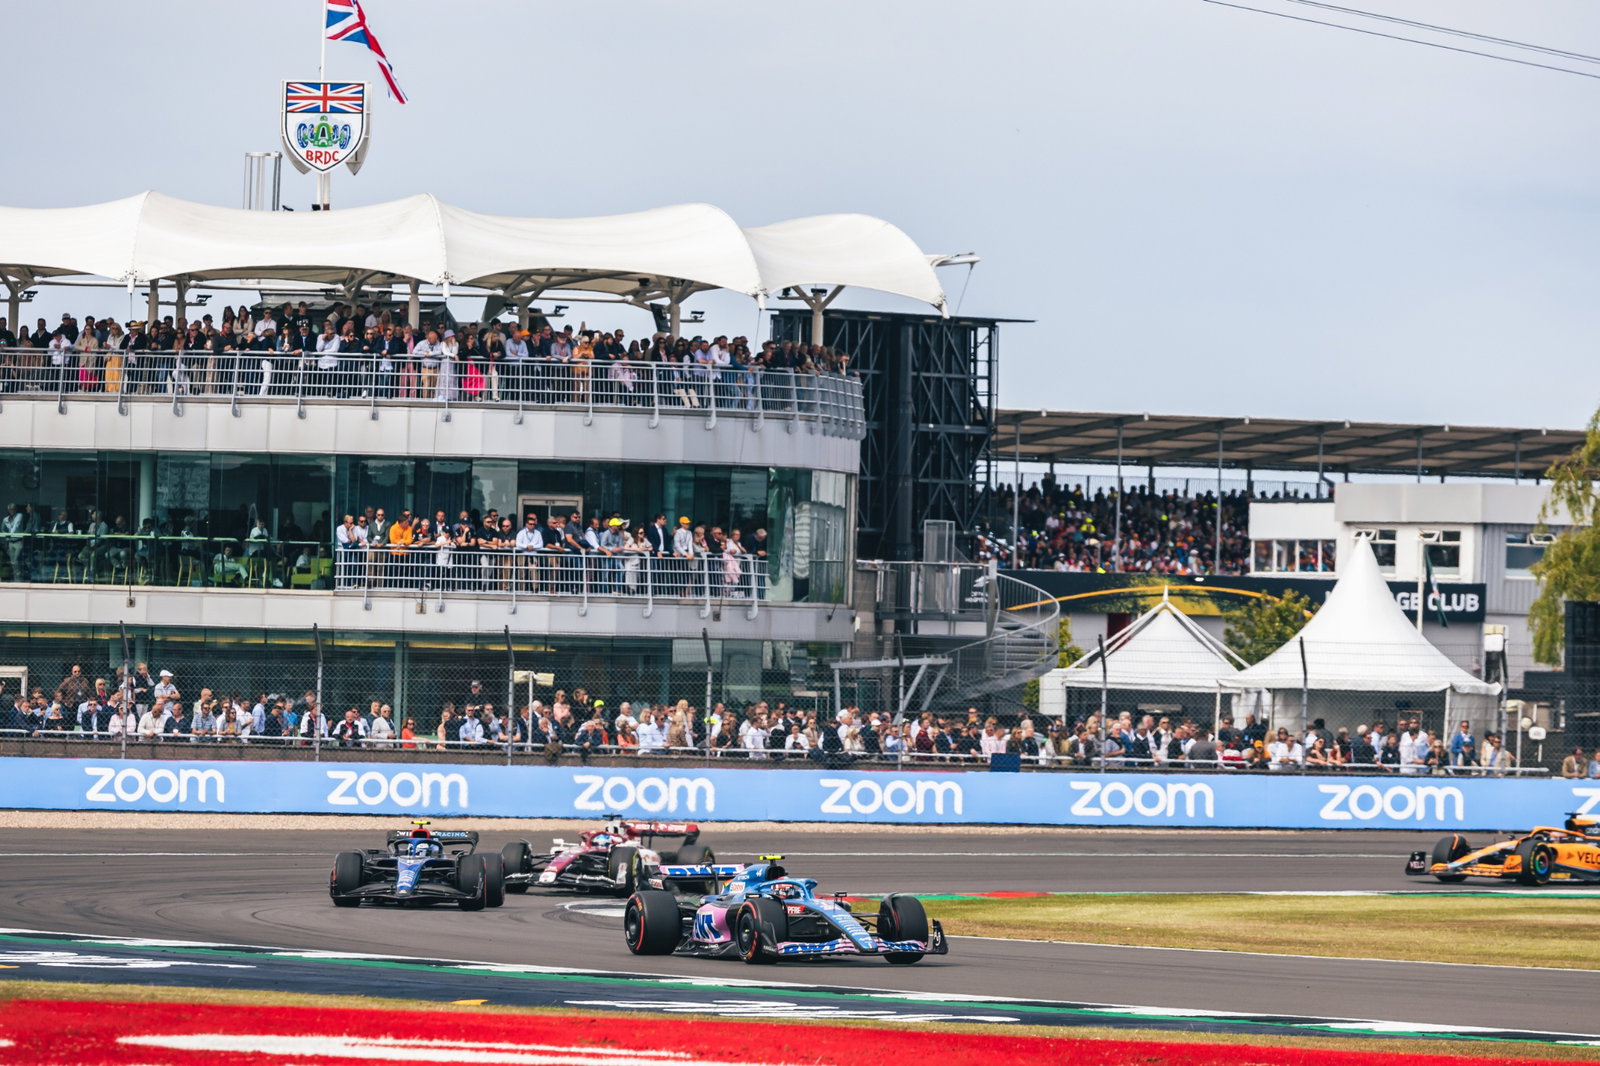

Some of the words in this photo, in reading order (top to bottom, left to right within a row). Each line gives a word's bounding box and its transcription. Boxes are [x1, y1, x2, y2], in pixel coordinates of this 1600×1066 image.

[305, 150, 339, 165] BRDC
[1427, 593, 1480, 612] CLUB
[85, 767, 224, 803] zoom
[327, 771, 468, 807] zoom
[574, 775, 715, 811] zoom
[820, 779, 963, 815] zoom
[1070, 782, 1214, 817] zoom
[1319, 785, 1464, 820] zoom
